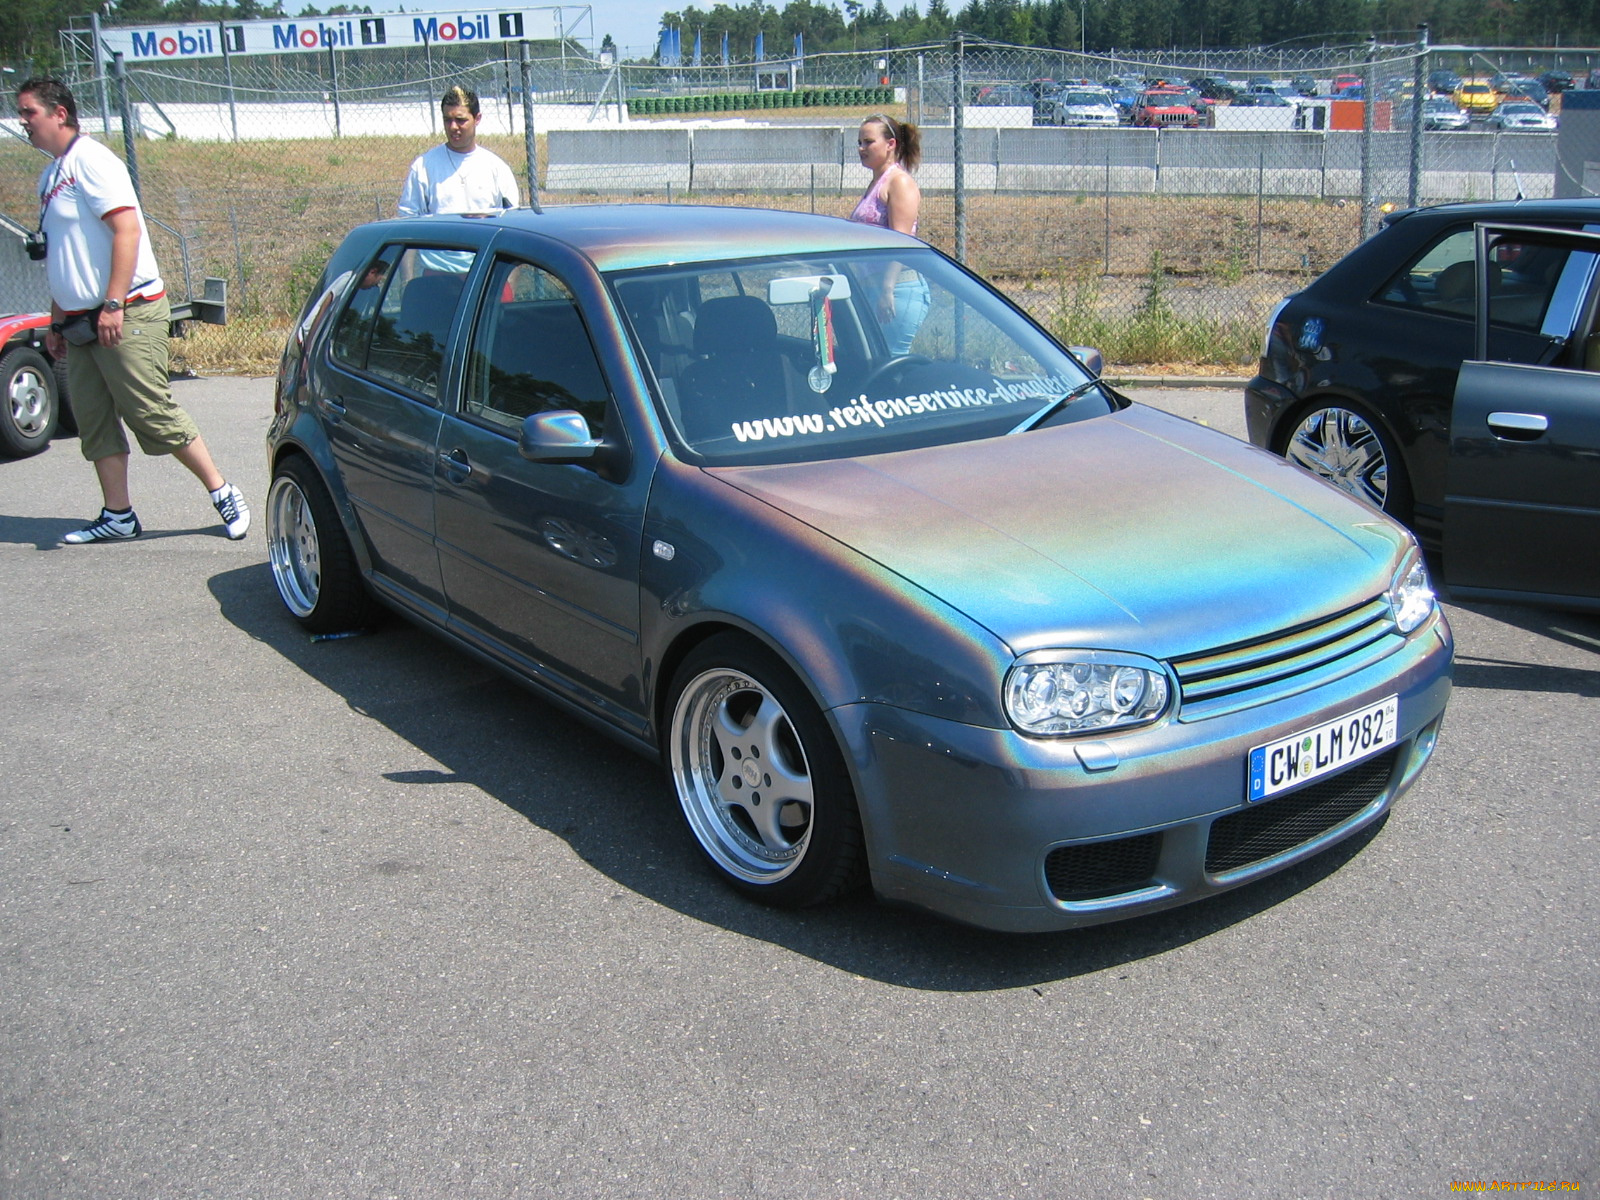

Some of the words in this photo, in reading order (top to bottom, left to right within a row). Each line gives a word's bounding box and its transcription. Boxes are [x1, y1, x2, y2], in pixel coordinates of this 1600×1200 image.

[272, 21, 354, 49] Mobil
[413, 14, 490, 42] Mobil
[131, 28, 214, 57] Mobil
[1270, 742, 1300, 786] CW
[1315, 725, 1343, 769] LM
[1349, 709, 1384, 756] 982
[1254, 778, 1261, 790] D
